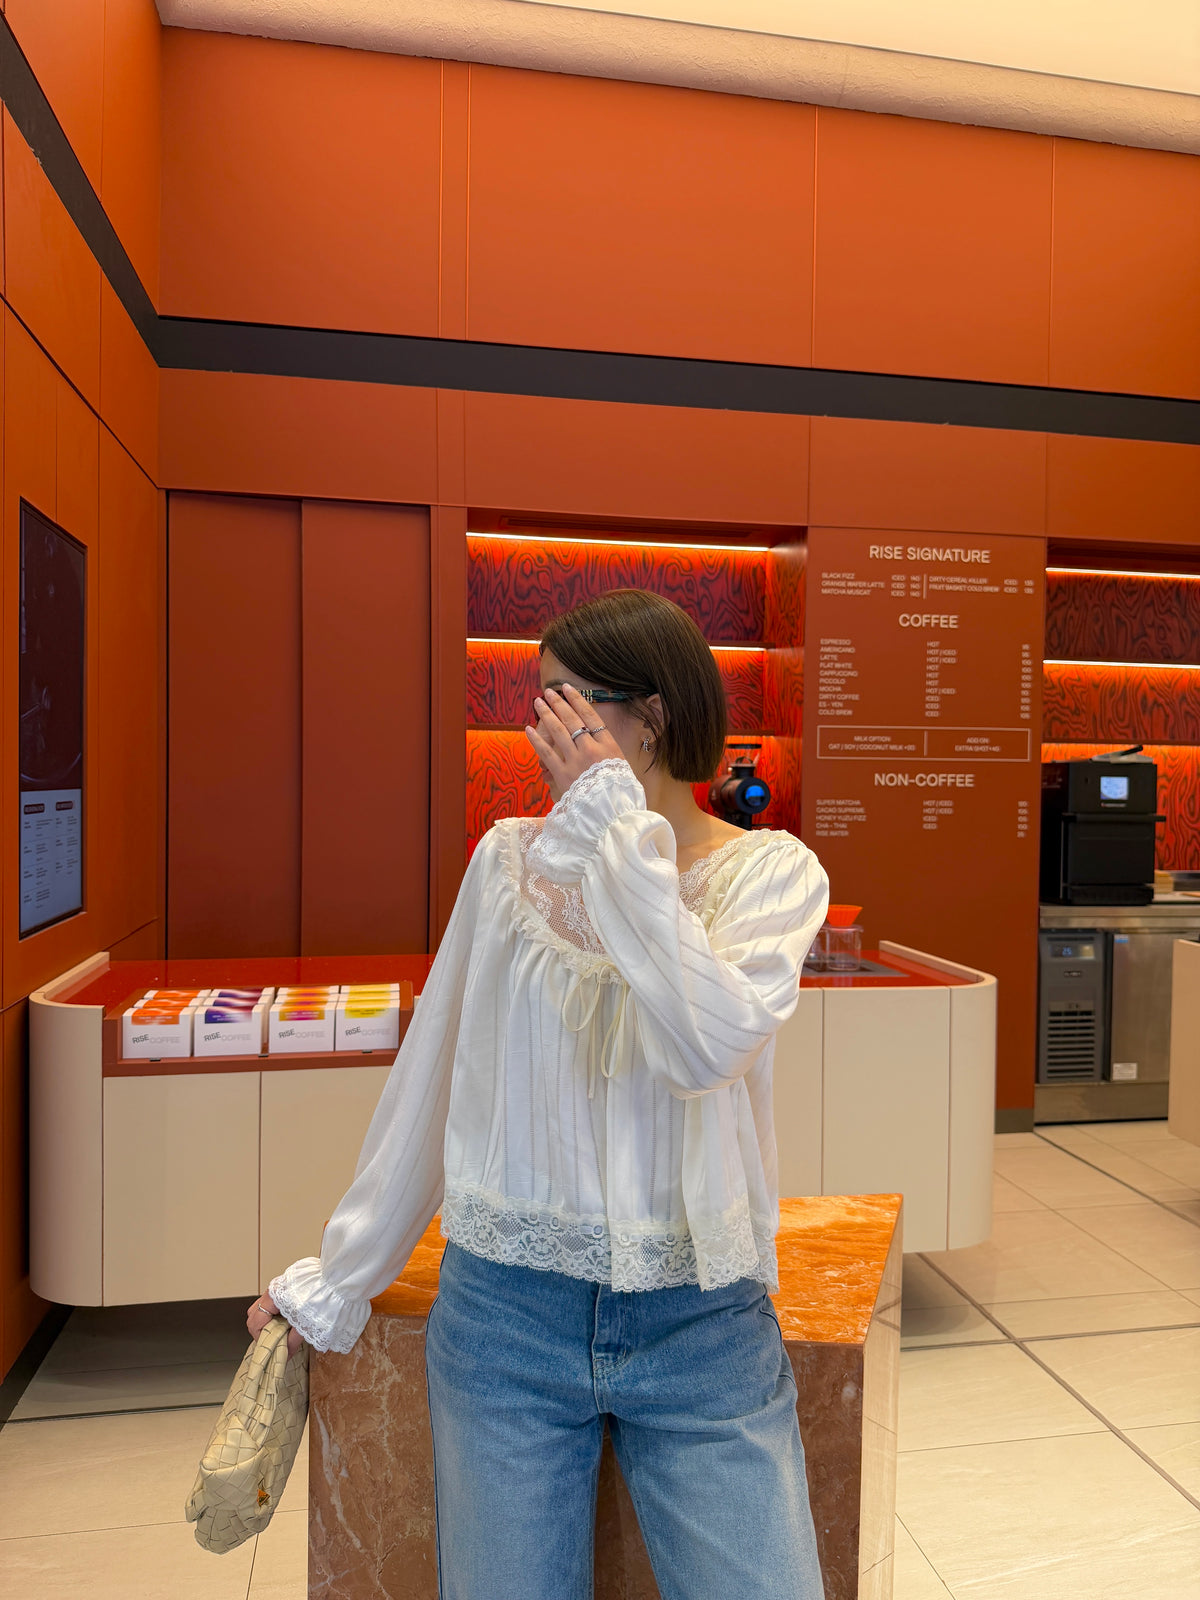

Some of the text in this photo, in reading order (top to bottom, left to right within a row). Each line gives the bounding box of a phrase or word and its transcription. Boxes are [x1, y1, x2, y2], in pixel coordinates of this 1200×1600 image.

[870, 545, 990, 563] RISE SIGNATURE
[868, 581, 885, 589] LATTE
[898, 613, 958, 629] COFFEE
[874, 773, 974, 788] NON-COFFEE
[278, 1028, 295, 1038] RISE
[345, 1026, 391, 1036] RISE COFFEE
[132, 1034, 181, 1044] RISE COFFEE
[204, 1032, 251, 1042] RISE COFFEE
